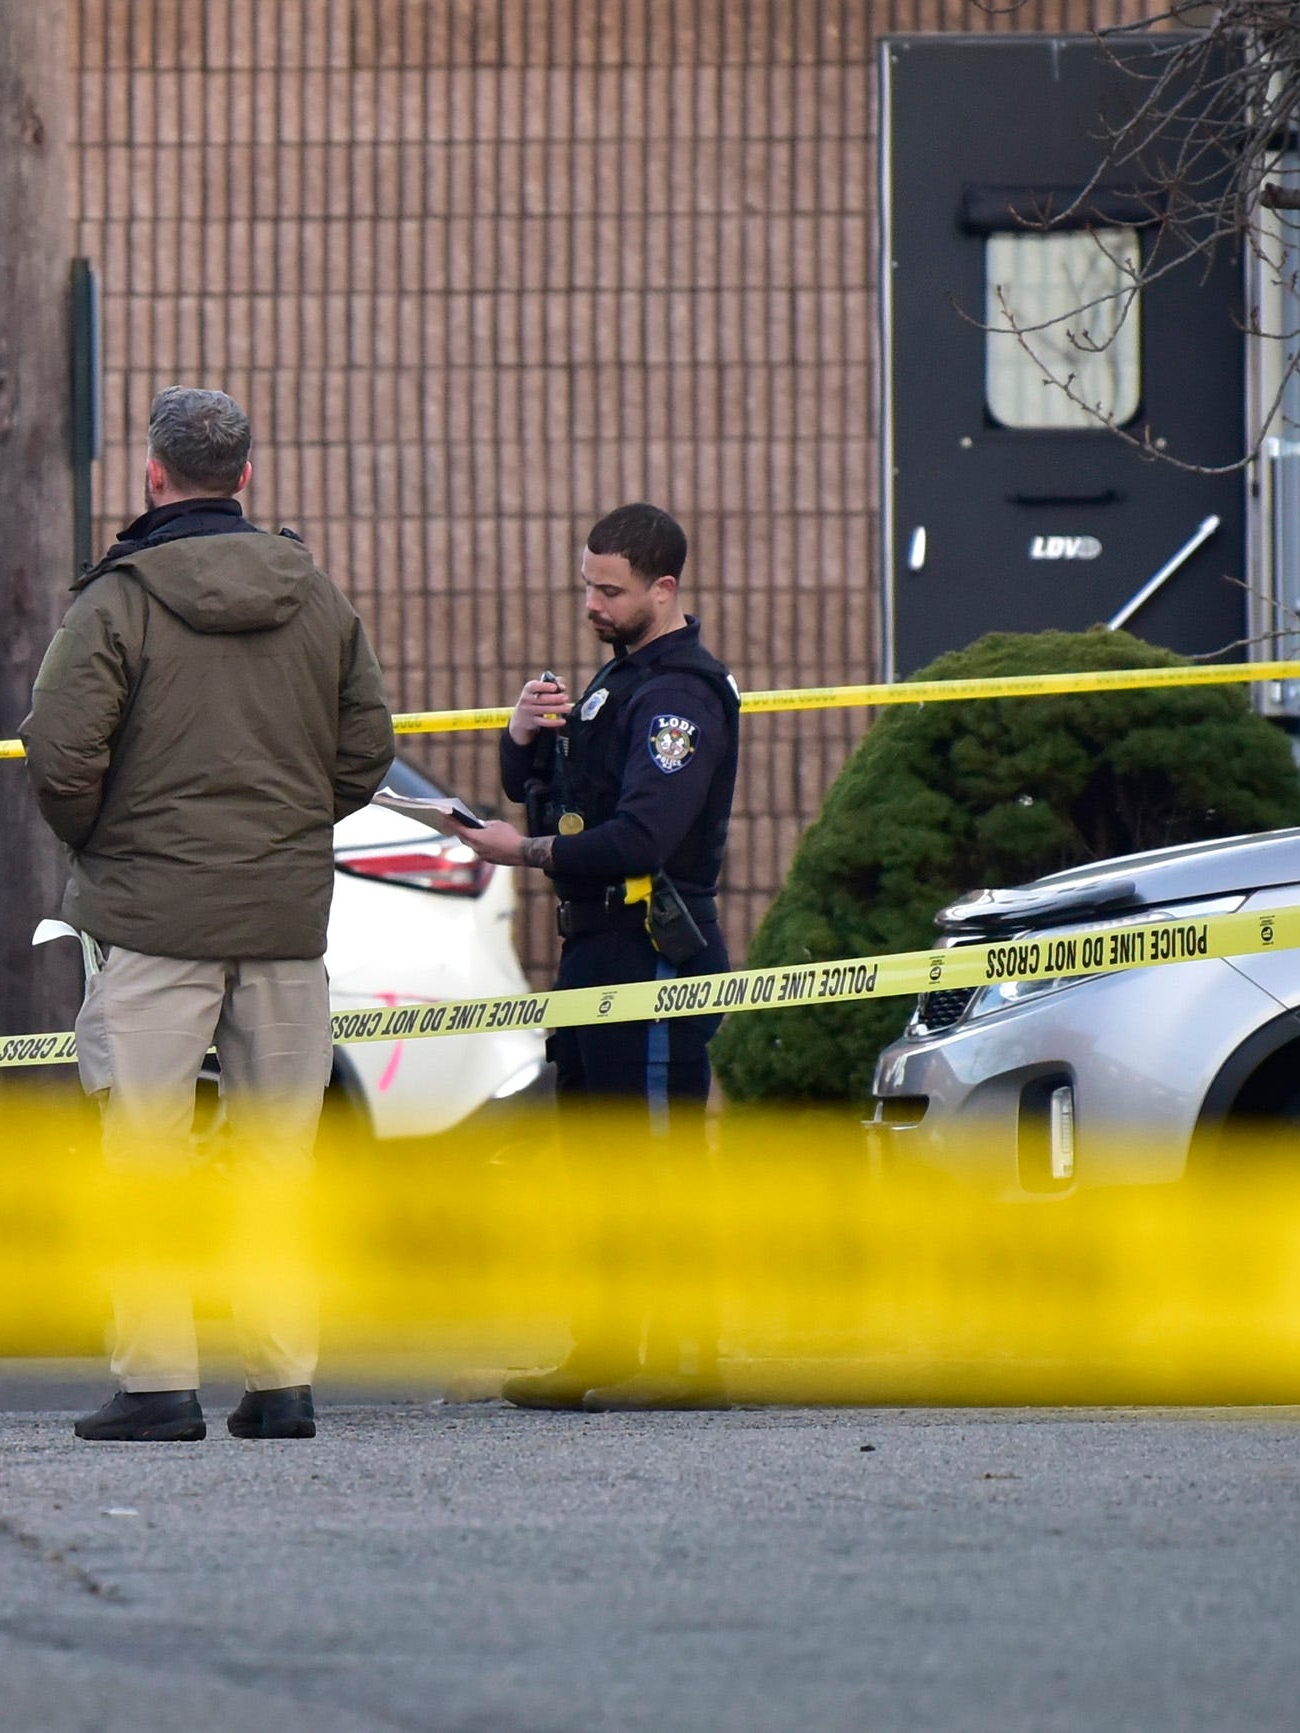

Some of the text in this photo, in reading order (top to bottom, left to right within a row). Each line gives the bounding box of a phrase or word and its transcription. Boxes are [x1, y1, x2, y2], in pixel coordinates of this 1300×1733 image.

[1032, 536, 1081, 559] LDV
[658, 717, 696, 736] LODI
[986, 923, 1208, 979] POLICE LINE DO NOT CROSS
[712, 978, 748, 1006] NOT
[750, 975, 776, 1003] DO
[778, 971, 816, 1001] LINE
[818, 964, 878, 997] POLICE
[654, 982, 710, 1013] CROSS
[380, 1010, 419, 1034] NOT
[420, 1008, 446, 1031] DO
[446, 1005, 483, 1029] LINE
[486, 1000, 548, 1026] POLICE
[54, 1035, 76, 1057] OT
